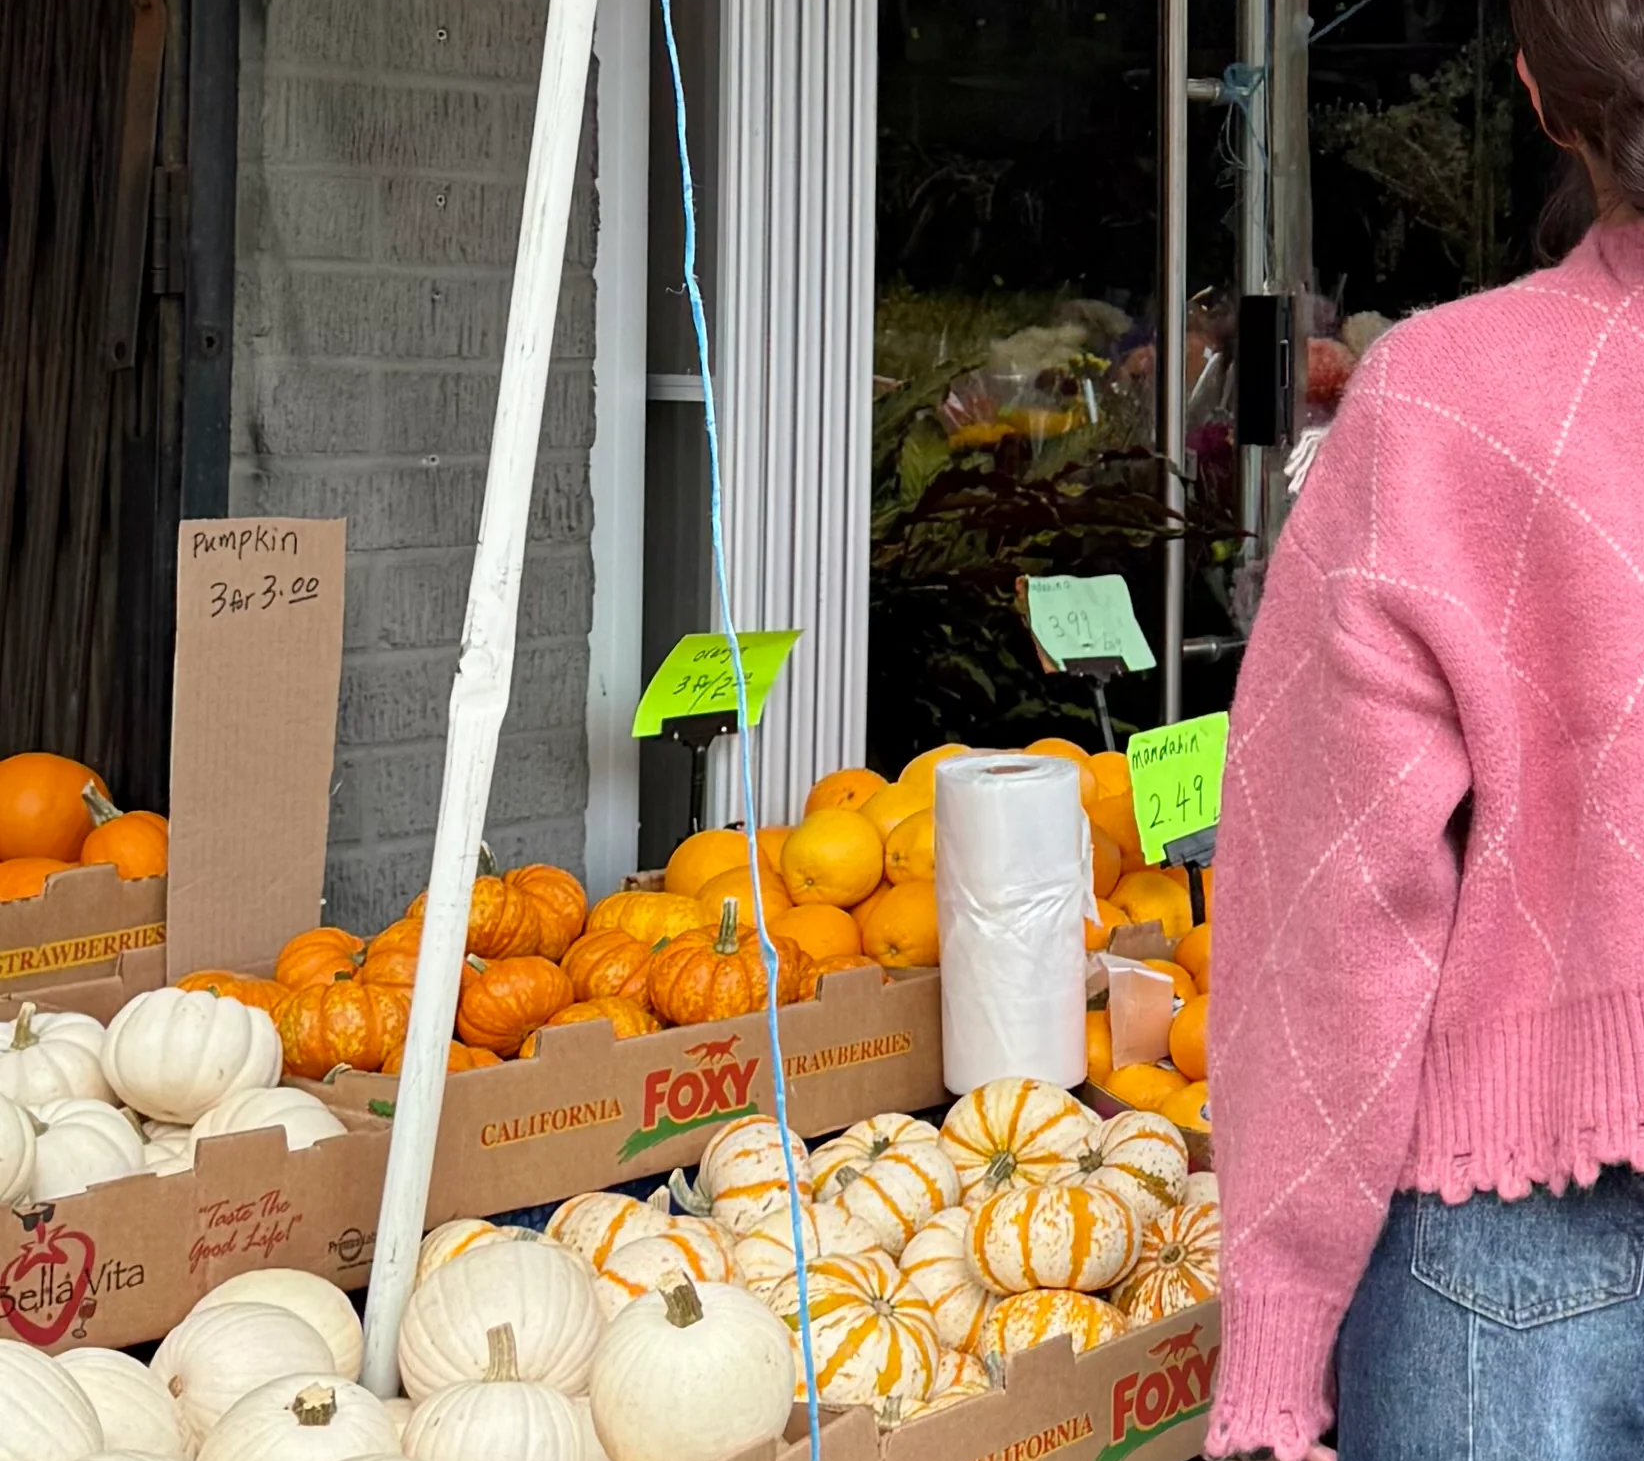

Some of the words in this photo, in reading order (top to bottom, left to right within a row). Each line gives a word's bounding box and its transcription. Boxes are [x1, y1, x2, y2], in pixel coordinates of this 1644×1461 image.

[209, 582, 228, 617] 3
[230, 590, 257, 614] for
[260, 574, 320, 610] 3.00
[1149, 774, 1205, 830] 2.49
[480, 1096, 623, 1147] CALIFORNIA
[641, 1056, 760, 1130] FOXY
[783, 1032, 912, 1079] TRAWBERRIES
[259, 1188, 291, 1218] The
[188, 1228, 239, 1275] Good
[84, 1258, 145, 1296] Vita
[1110, 1344, 1221, 1442] FOXY
